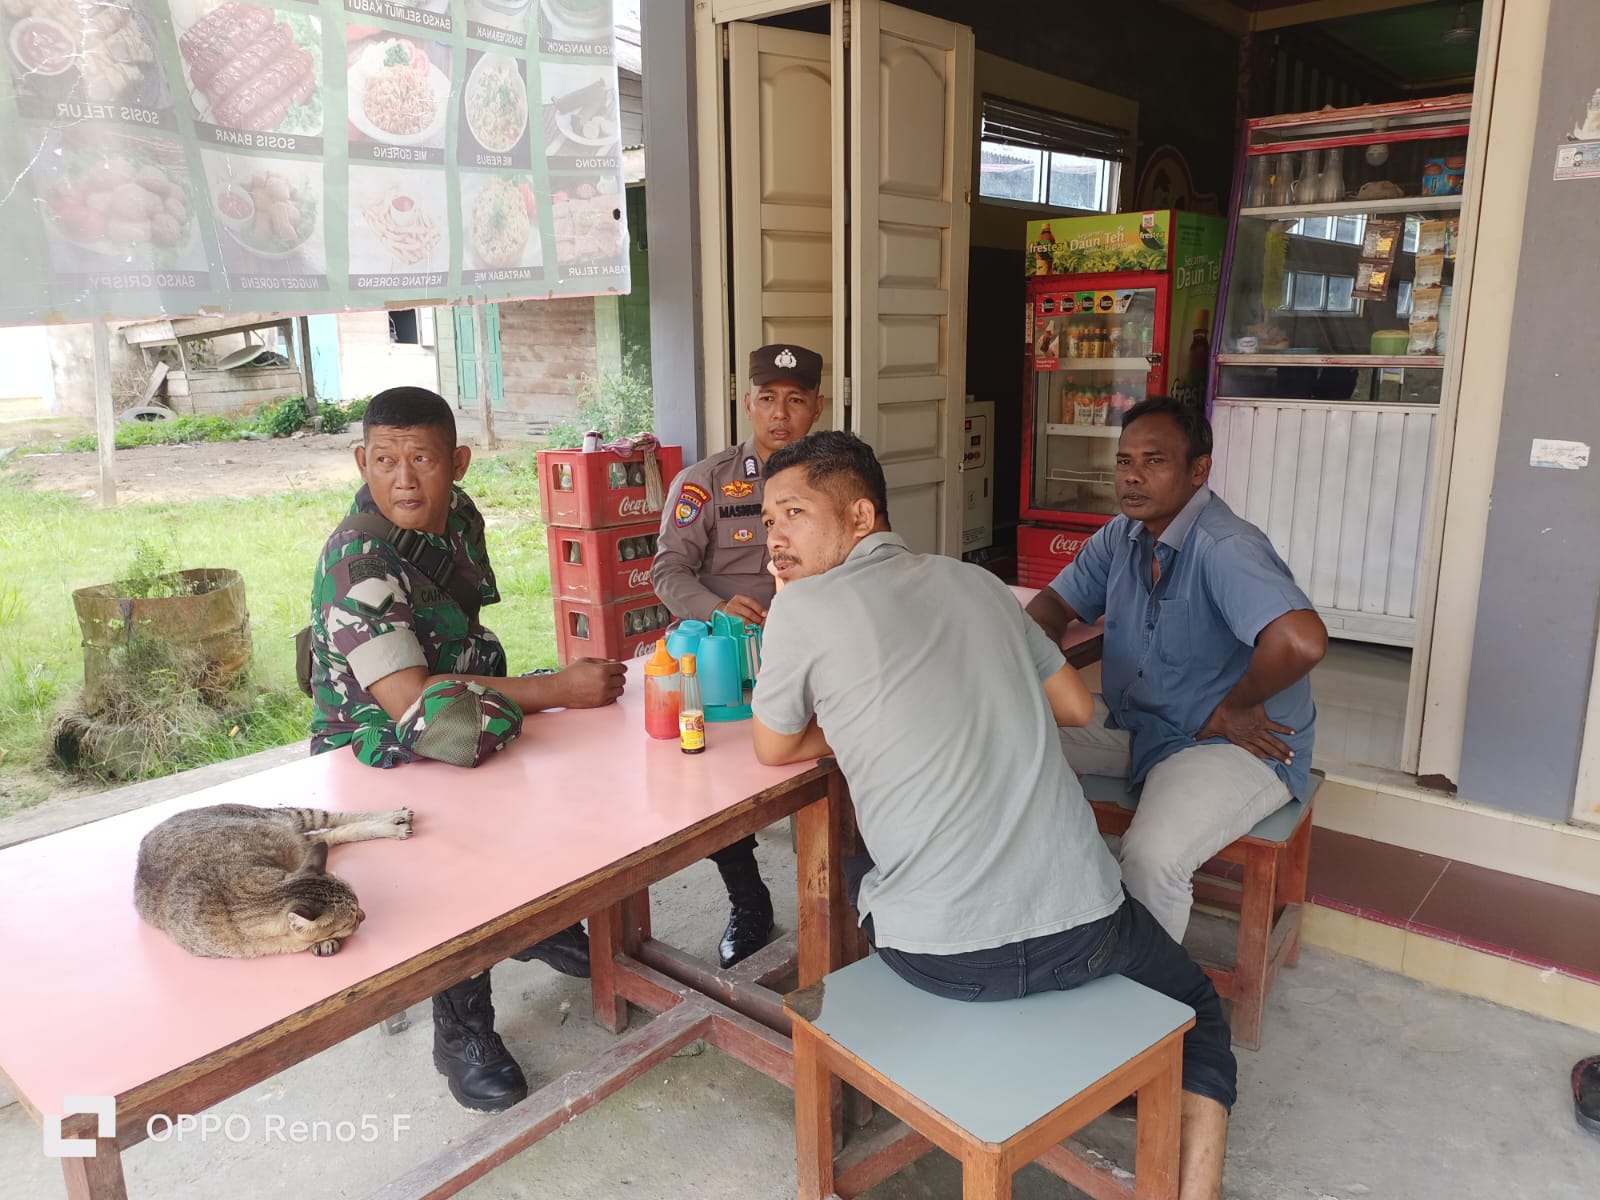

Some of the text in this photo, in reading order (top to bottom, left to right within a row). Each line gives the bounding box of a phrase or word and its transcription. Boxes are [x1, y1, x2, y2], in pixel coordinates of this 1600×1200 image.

[1030, 242, 1065, 253] frestea
[1070, 238, 1100, 251] Daun
[1104, 229, 1124, 243] Teh
[1176, 266, 1205, 290] Daun
